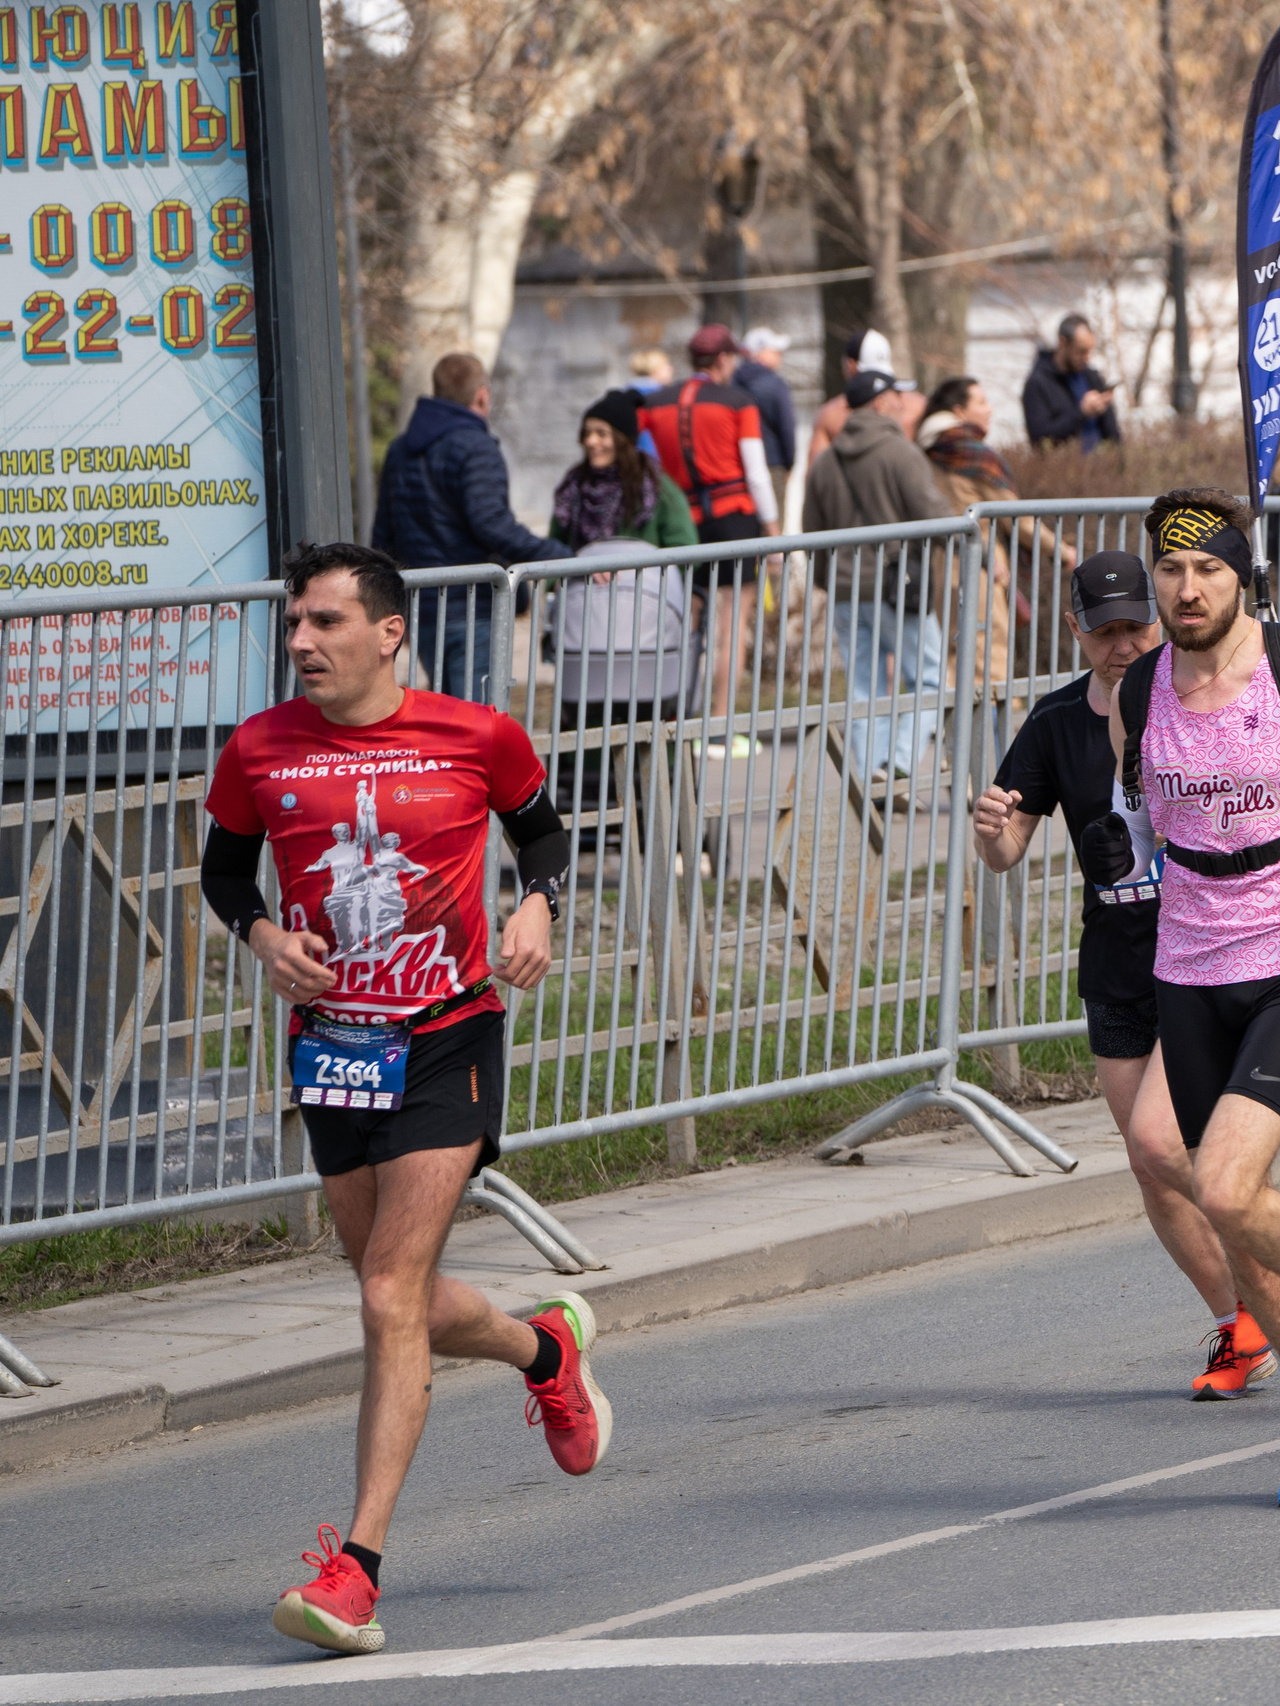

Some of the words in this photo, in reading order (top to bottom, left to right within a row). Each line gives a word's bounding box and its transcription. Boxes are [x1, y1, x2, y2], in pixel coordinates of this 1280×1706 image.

[61, 444, 190, 473] РЕКЛАМЫ
[73, 479, 259, 511] ПАВИЛЬОНАХ,
[37, 524, 56, 550] И
[61, 520, 169, 549] ХОРЕКЕ.
[1163, 508, 1222, 552] TRAIL
[1194, 520, 1229, 551] SAMARA
[0, 560, 148, 589] 2440008.ru
[269, 766, 329, 780] «МОЯ
[333, 759, 453, 776] СТОЛИЦА»
[306, 749, 420, 764] ПОЛУМАРАФОН
[1156, 772, 1233, 807] Magic
[1223, 783, 1275, 829] pills
[314, 1053, 382, 1088] 2364
